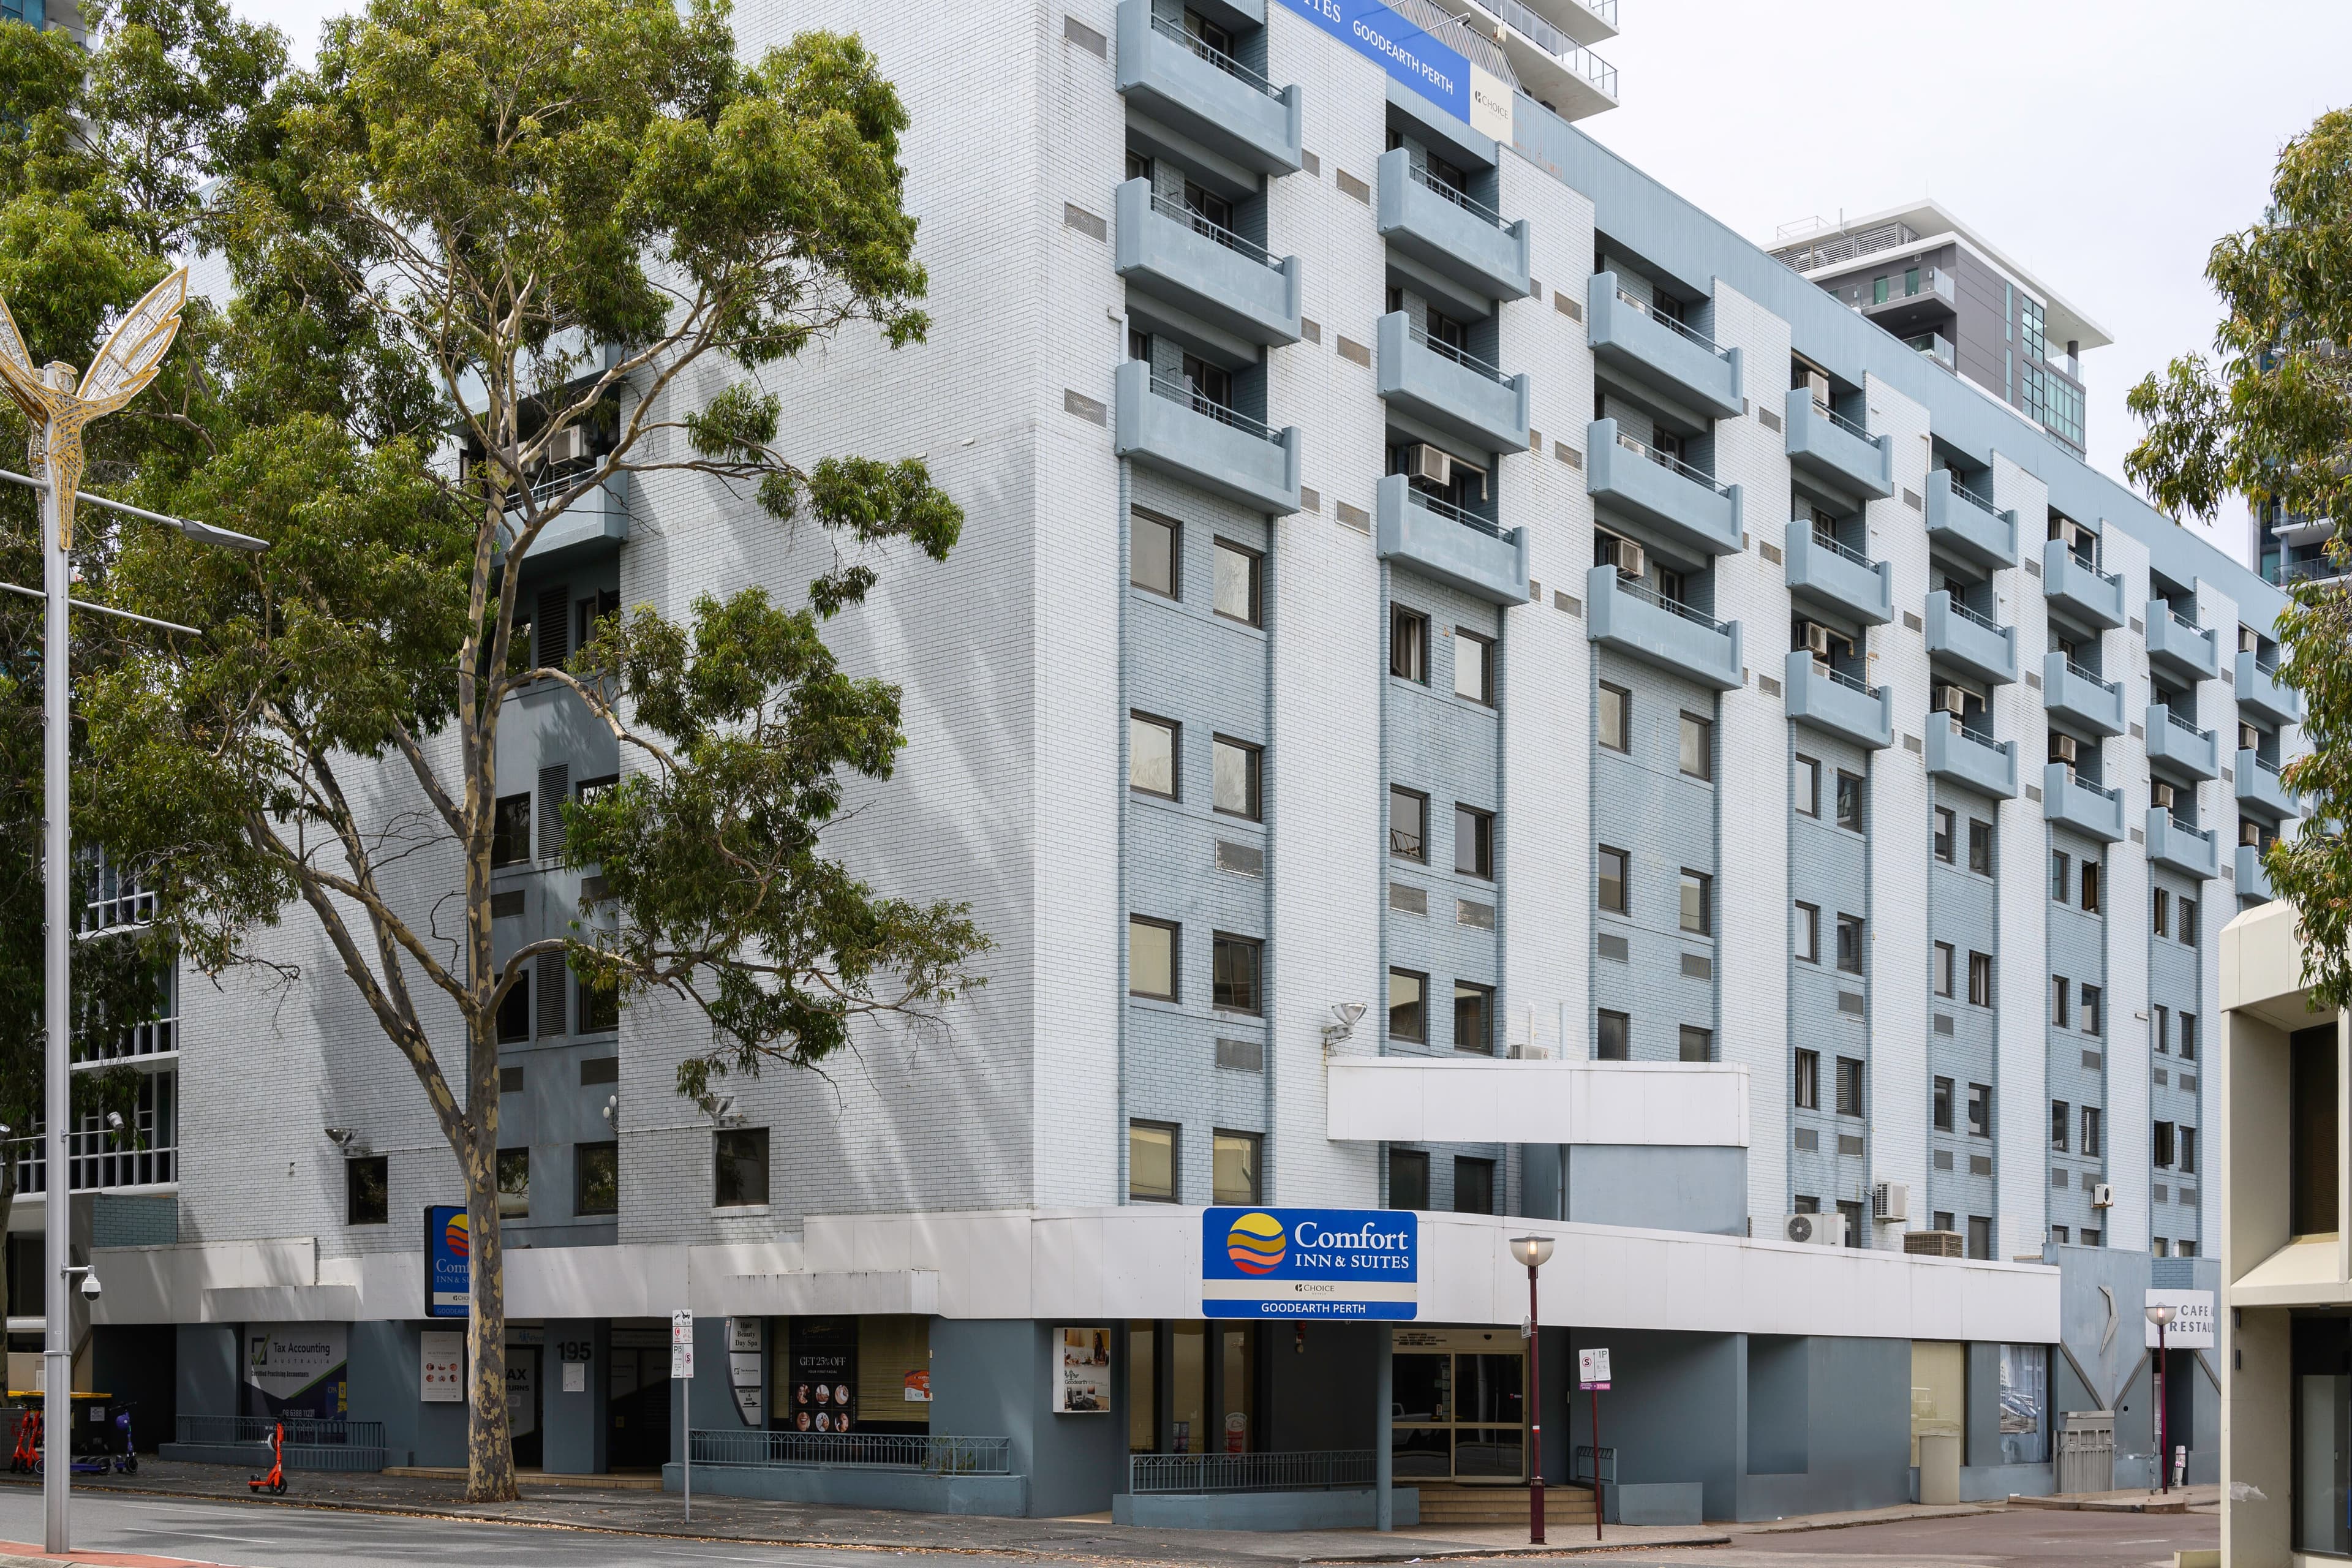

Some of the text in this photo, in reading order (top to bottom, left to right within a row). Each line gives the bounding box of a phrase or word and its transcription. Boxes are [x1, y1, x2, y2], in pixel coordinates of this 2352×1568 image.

[1352, 20, 1419, 74] GOODEARTH
[1422, 62, 1453, 96] PERTH
[1482, 95, 1509, 119] CHOICE
[1294, 1221, 1409, 1250] Comfort
[1295, 1254, 1409, 1269] INN & SUITES
[1261, 1302, 1366, 1314] GOODEARTH PERTH
[2180, 1305, 2208, 1317] CAFE
[737, 1330, 756, 1339] Beauty
[273, 1342, 331, 1356] Tax Accounting
[557, 1341, 592, 1361] 195
[799, 1357, 846, 1366] GET 25% OFF
[505, 1368, 527, 1381] AX
